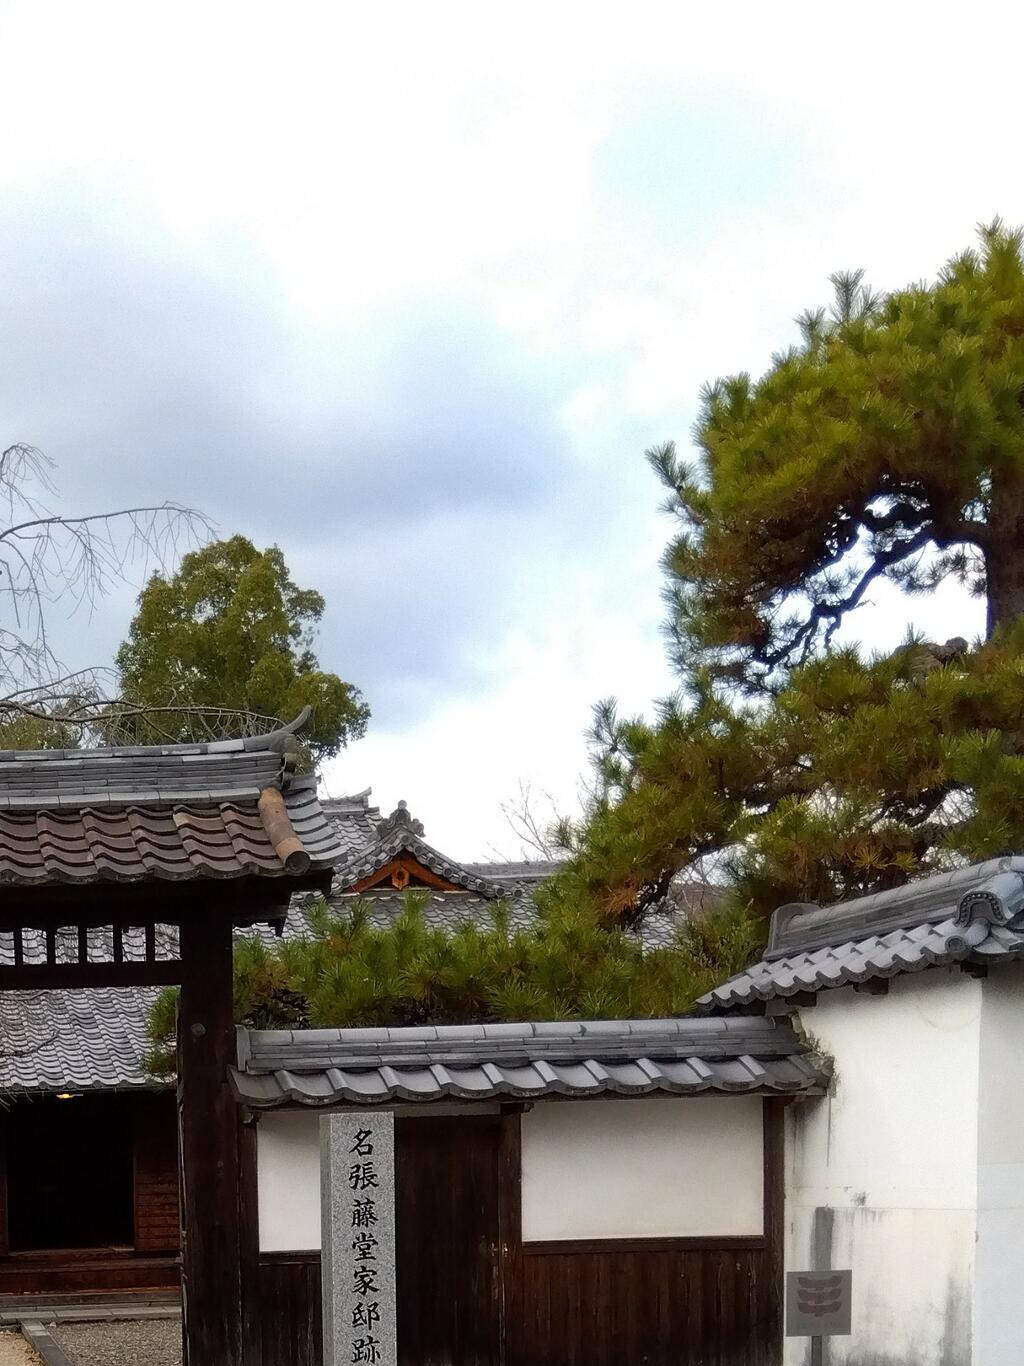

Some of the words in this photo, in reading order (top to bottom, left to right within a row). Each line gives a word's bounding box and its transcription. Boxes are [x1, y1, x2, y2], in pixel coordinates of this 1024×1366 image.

[348, 1127, 382, 1365] 名張藤堂家邸跡
